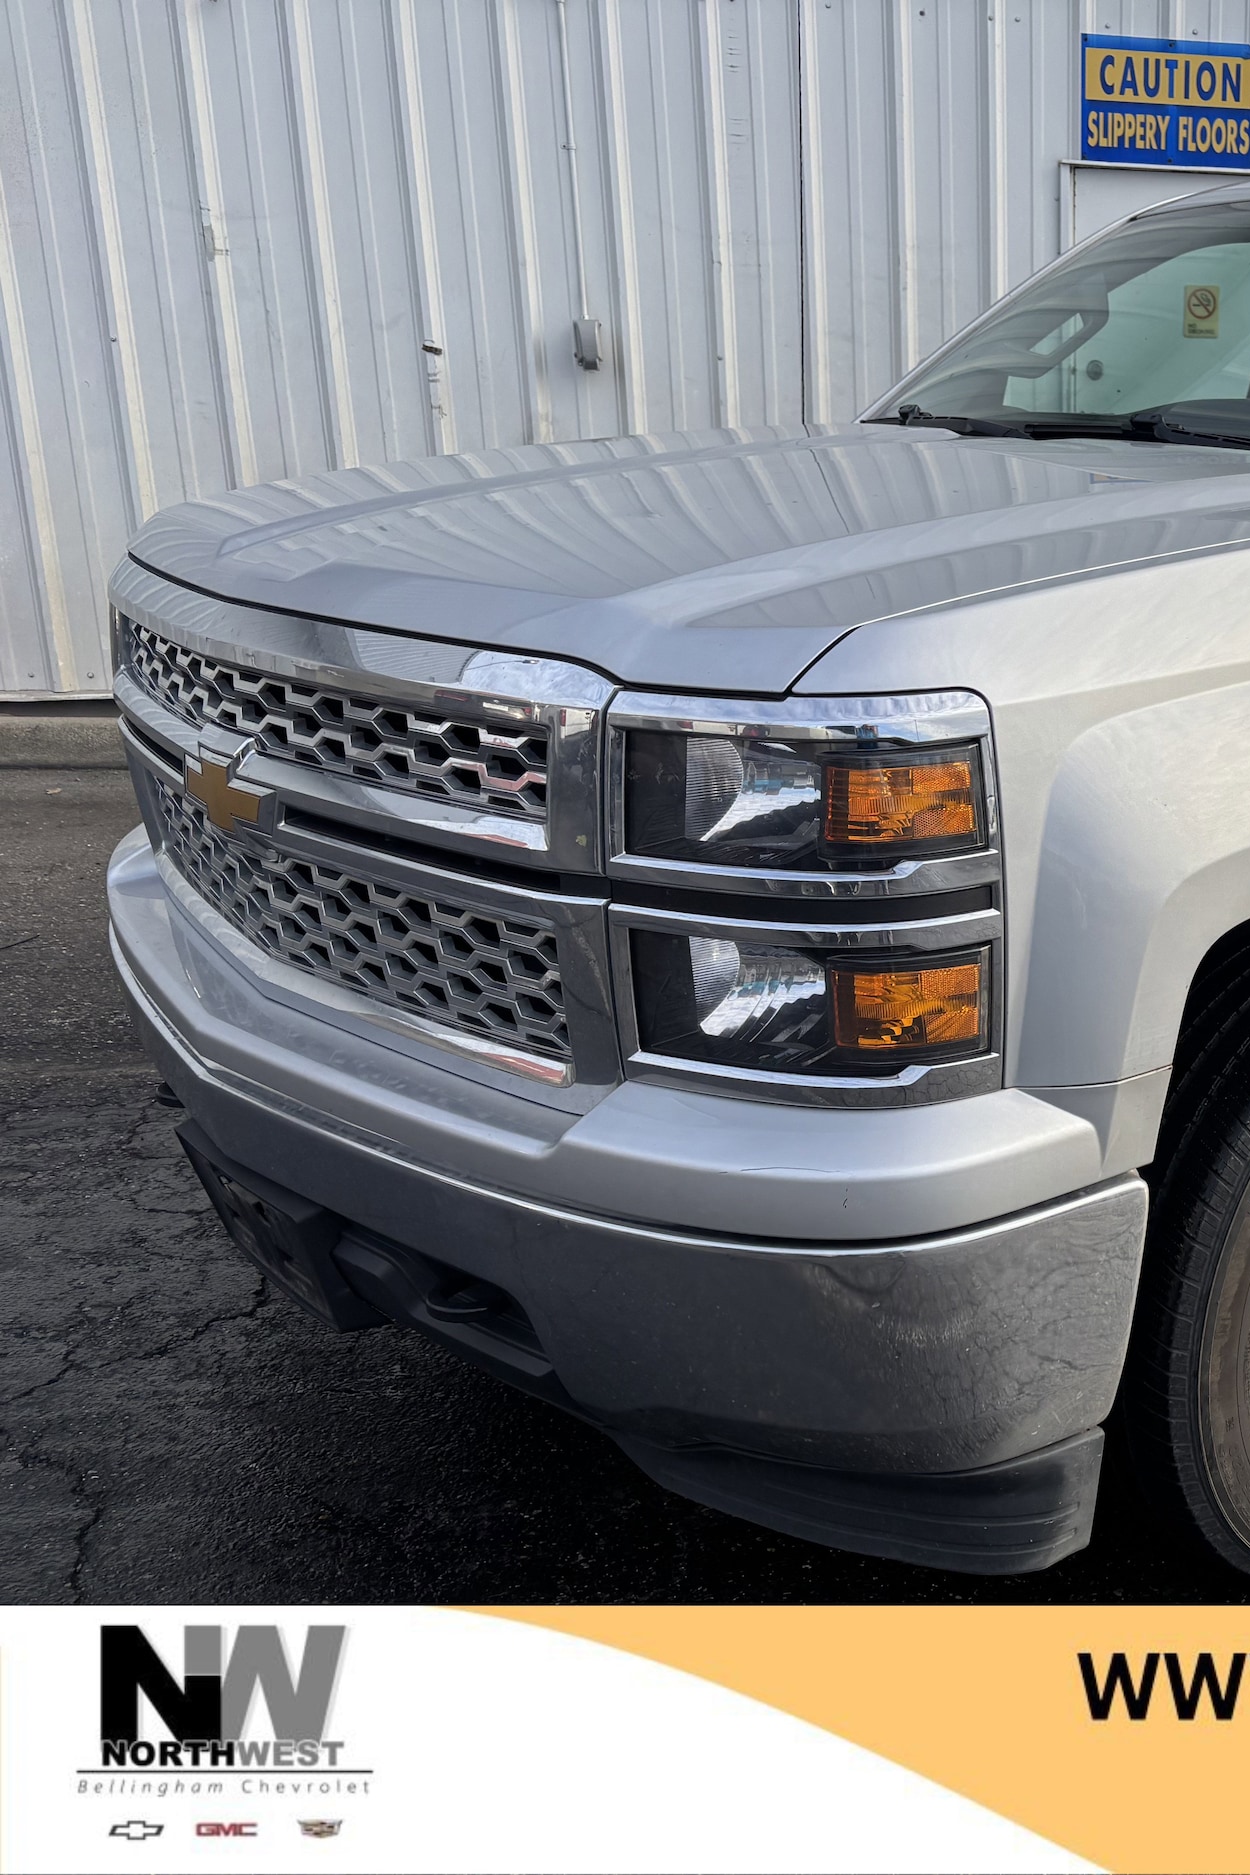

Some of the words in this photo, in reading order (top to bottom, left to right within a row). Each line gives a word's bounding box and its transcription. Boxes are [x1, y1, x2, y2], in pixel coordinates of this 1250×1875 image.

[1100, 54, 1242, 103] CAUTION
[1087, 110, 1170, 151] SLIPPERY
[1178, 116, 1250, 155] FLOORS
